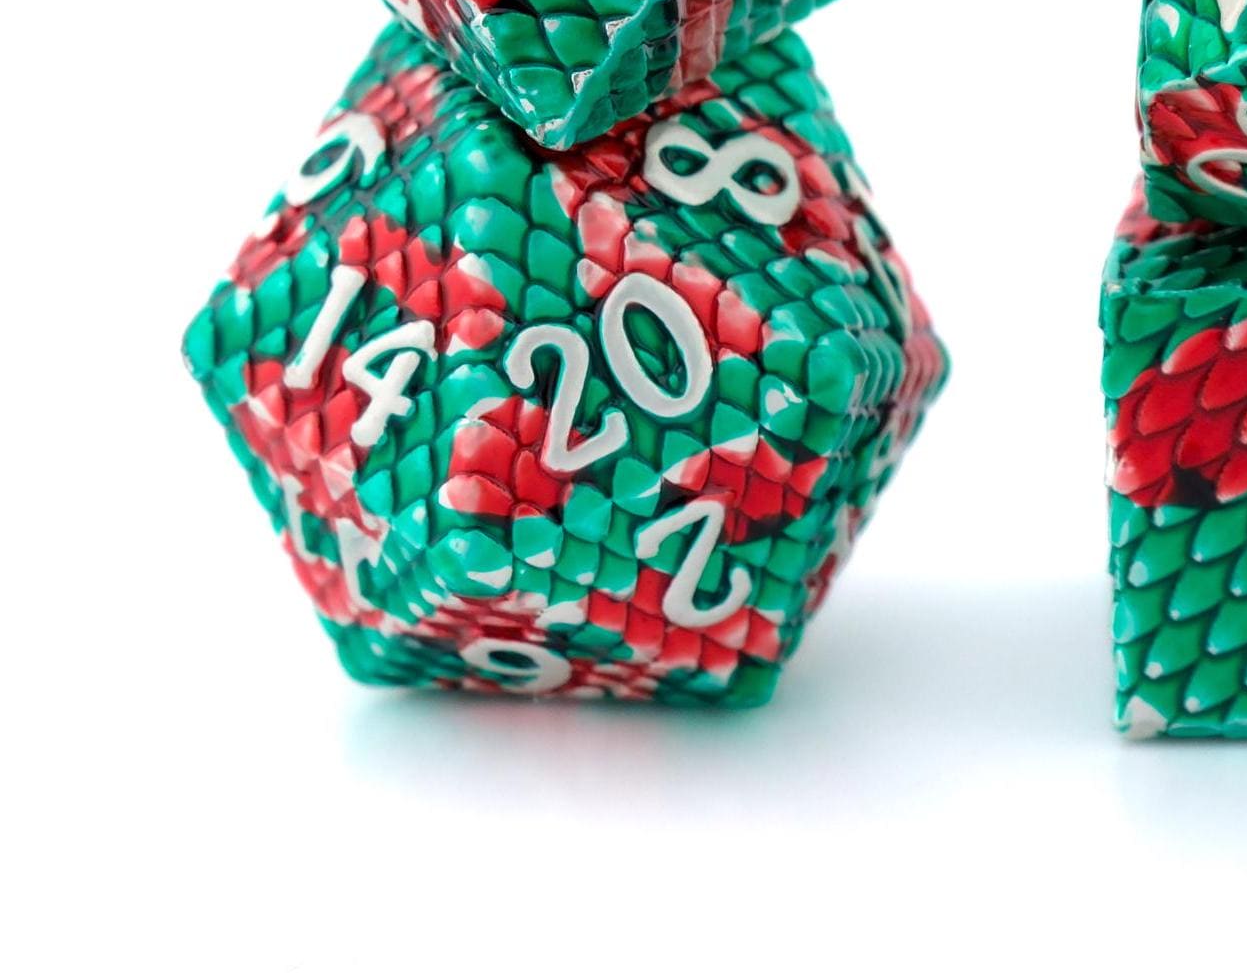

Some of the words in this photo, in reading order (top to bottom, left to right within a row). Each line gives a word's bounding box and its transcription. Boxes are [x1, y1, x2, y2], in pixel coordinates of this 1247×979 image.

[645, 119, 800, 225] 8
[284, 264, 438, 446] 14
[503, 271, 713, 473] 20
[636, 500, 752, 629] 2
